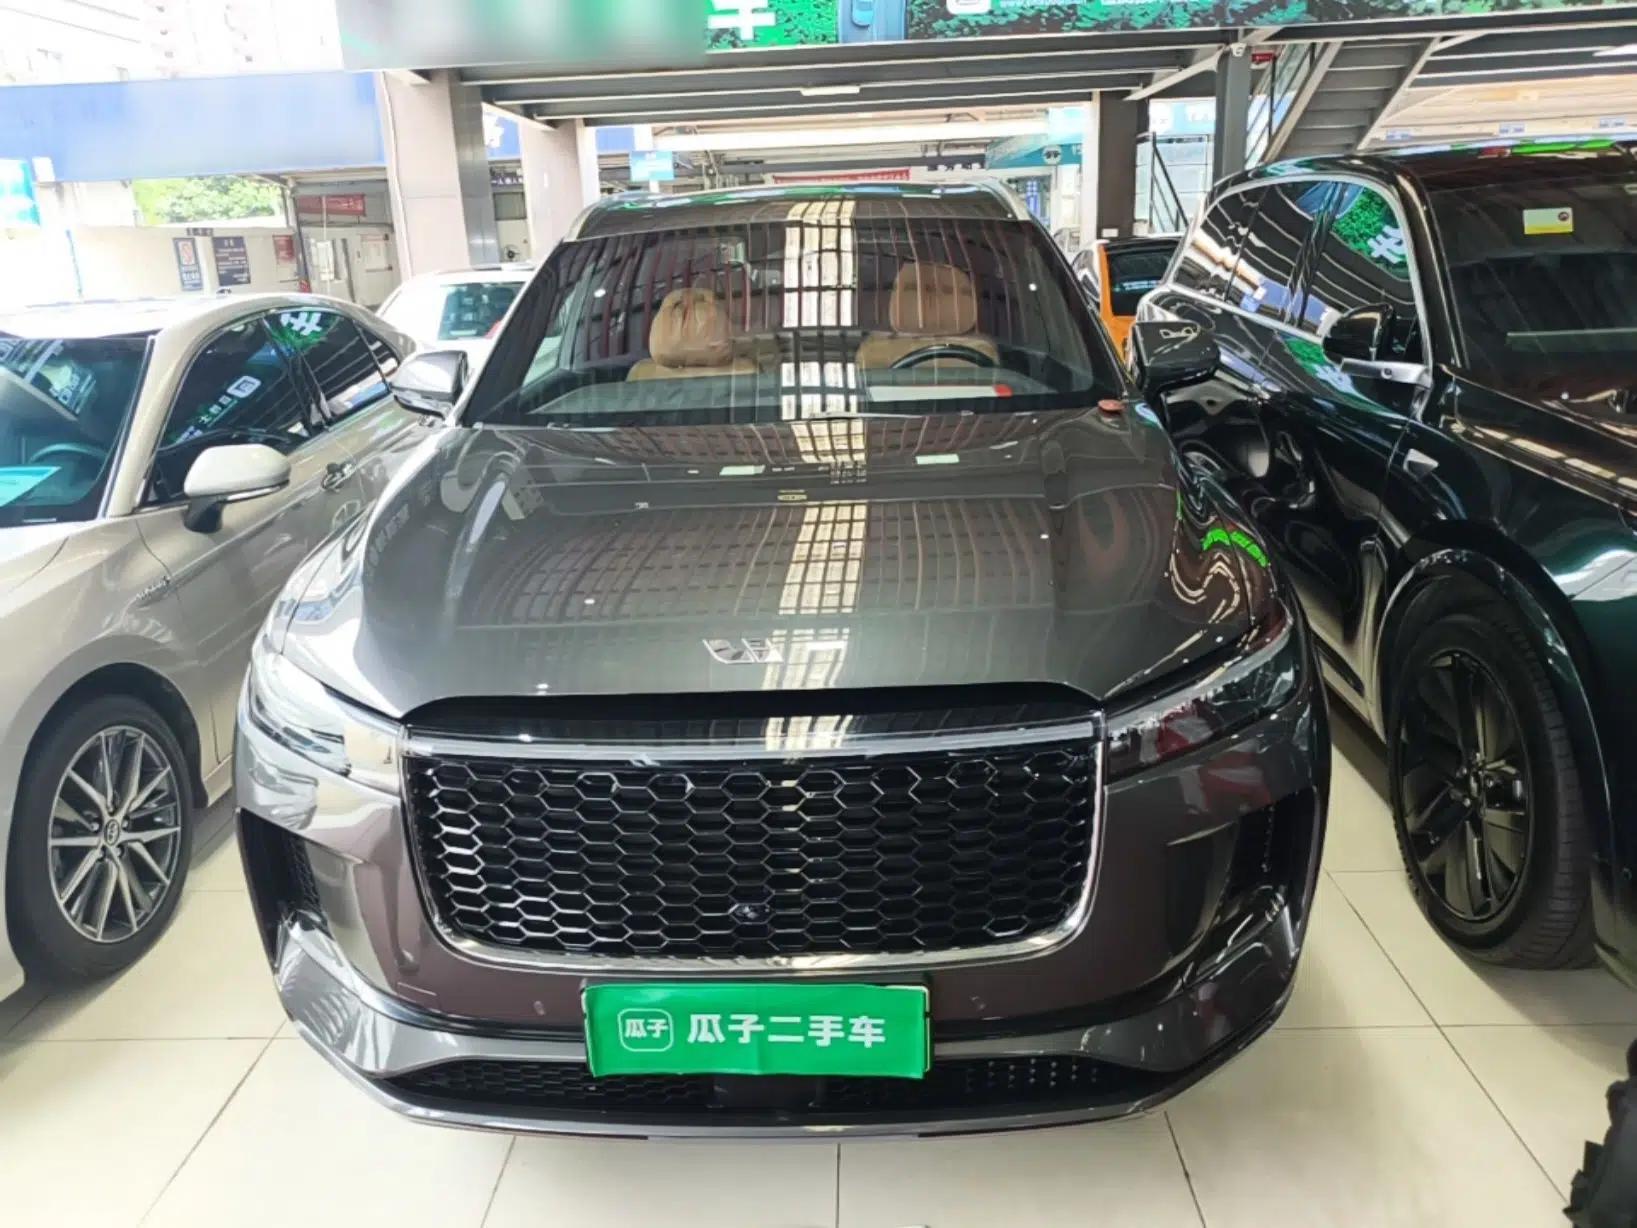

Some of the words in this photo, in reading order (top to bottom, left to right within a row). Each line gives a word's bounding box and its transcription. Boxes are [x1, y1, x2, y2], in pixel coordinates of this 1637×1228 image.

[625, 1018, 668, 1038] 瓜子
[687, 1014, 886, 1048] 瓜子二手车
